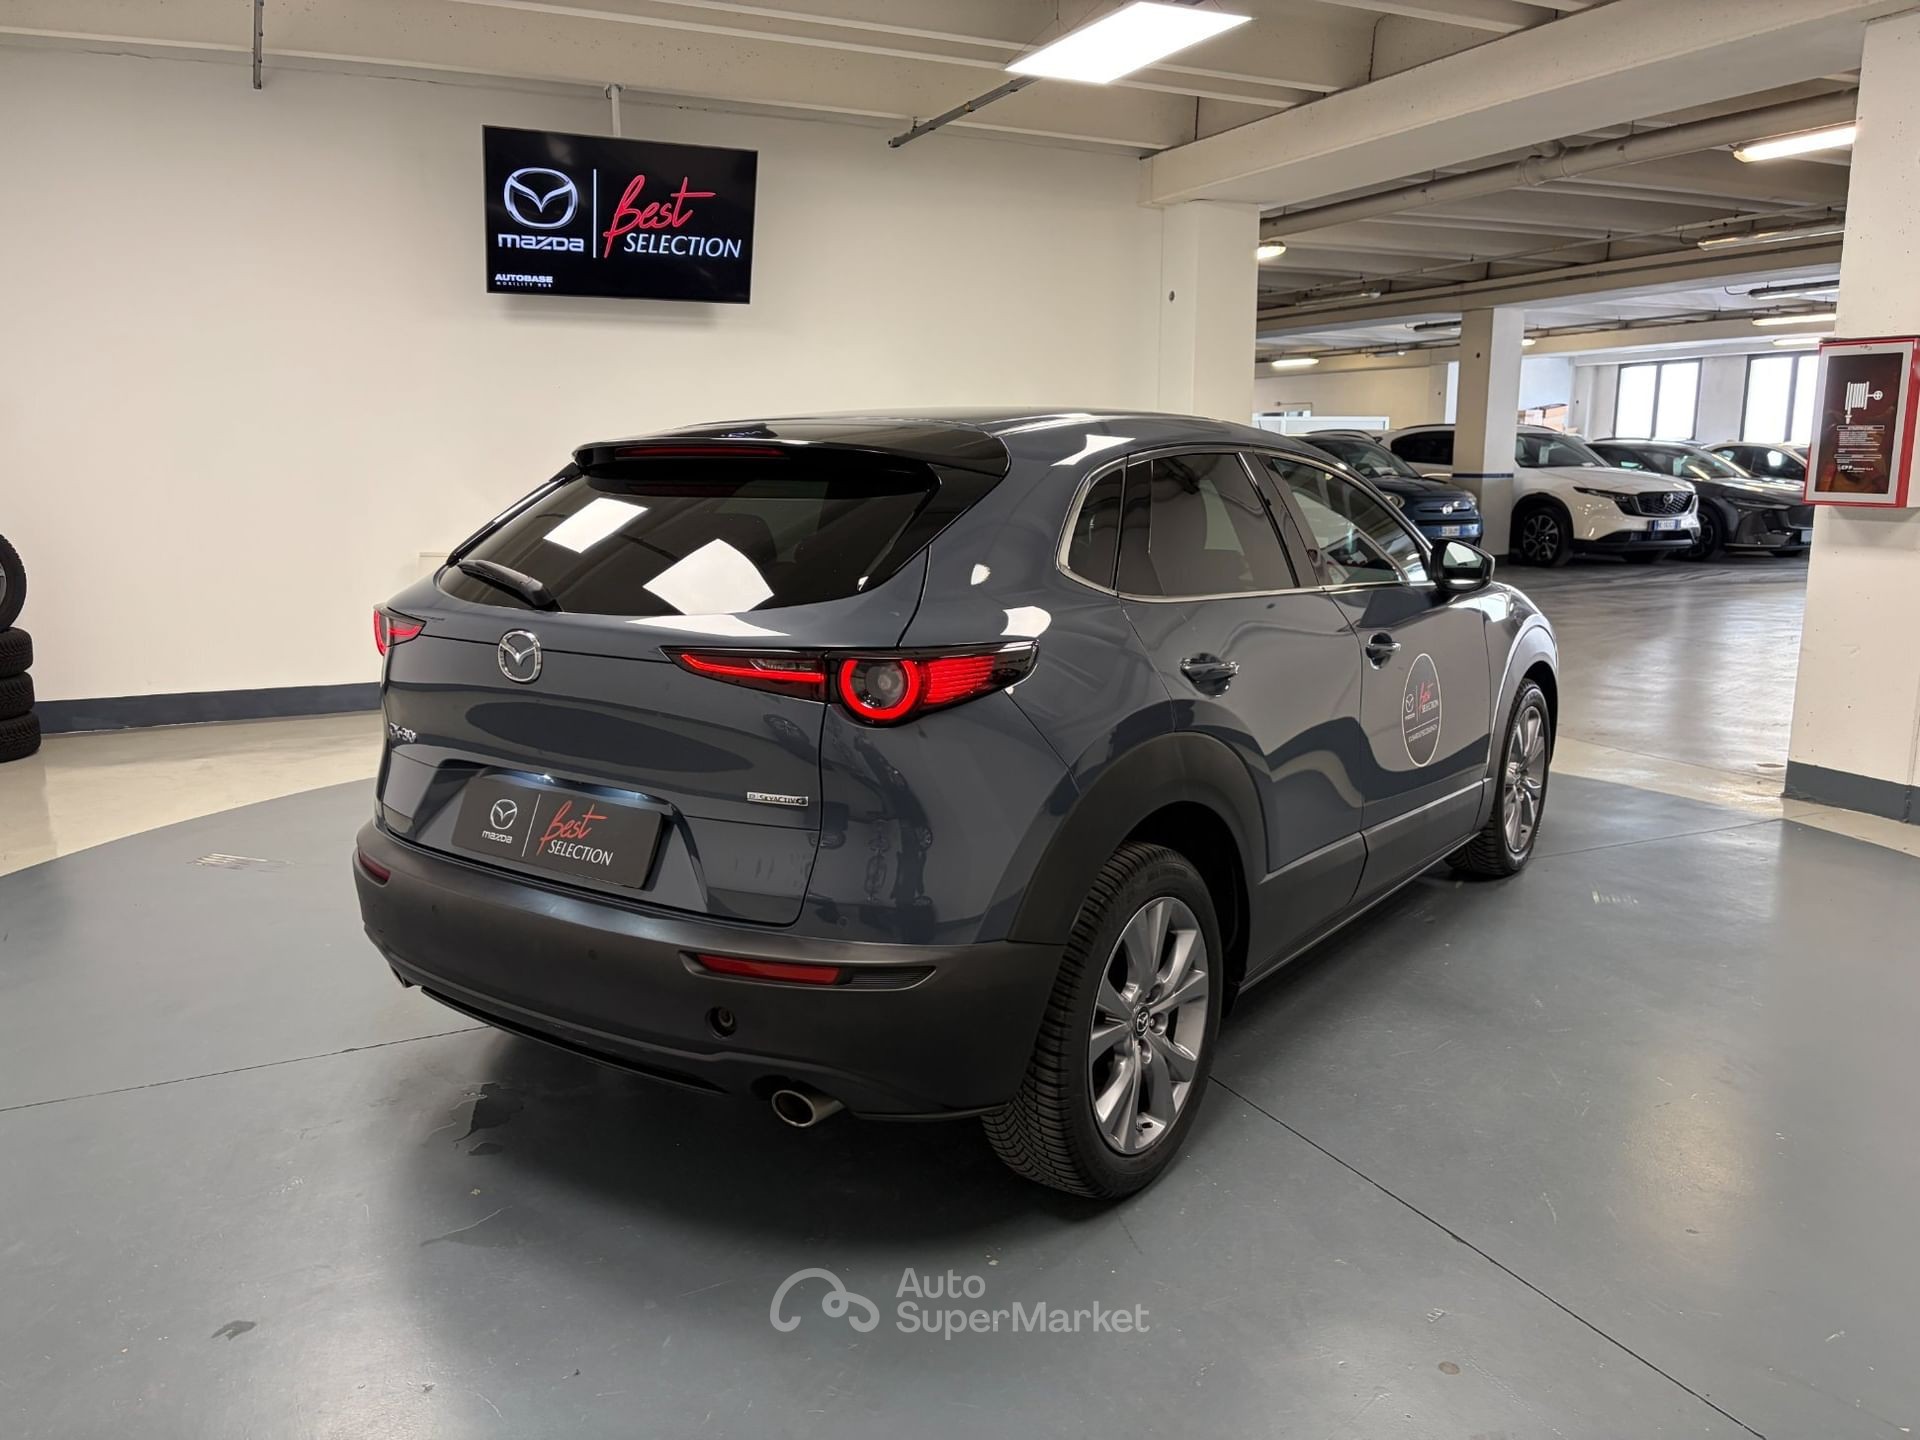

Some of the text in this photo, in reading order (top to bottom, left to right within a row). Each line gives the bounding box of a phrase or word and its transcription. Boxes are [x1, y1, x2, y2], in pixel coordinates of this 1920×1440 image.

[603, 175, 716, 258] Best
[623, 232, 742, 258] SELECTION
[494, 273, 554, 283] AUTOBASE
[536, 799, 608, 856] Best
[547, 839, 613, 866] SELECTION
